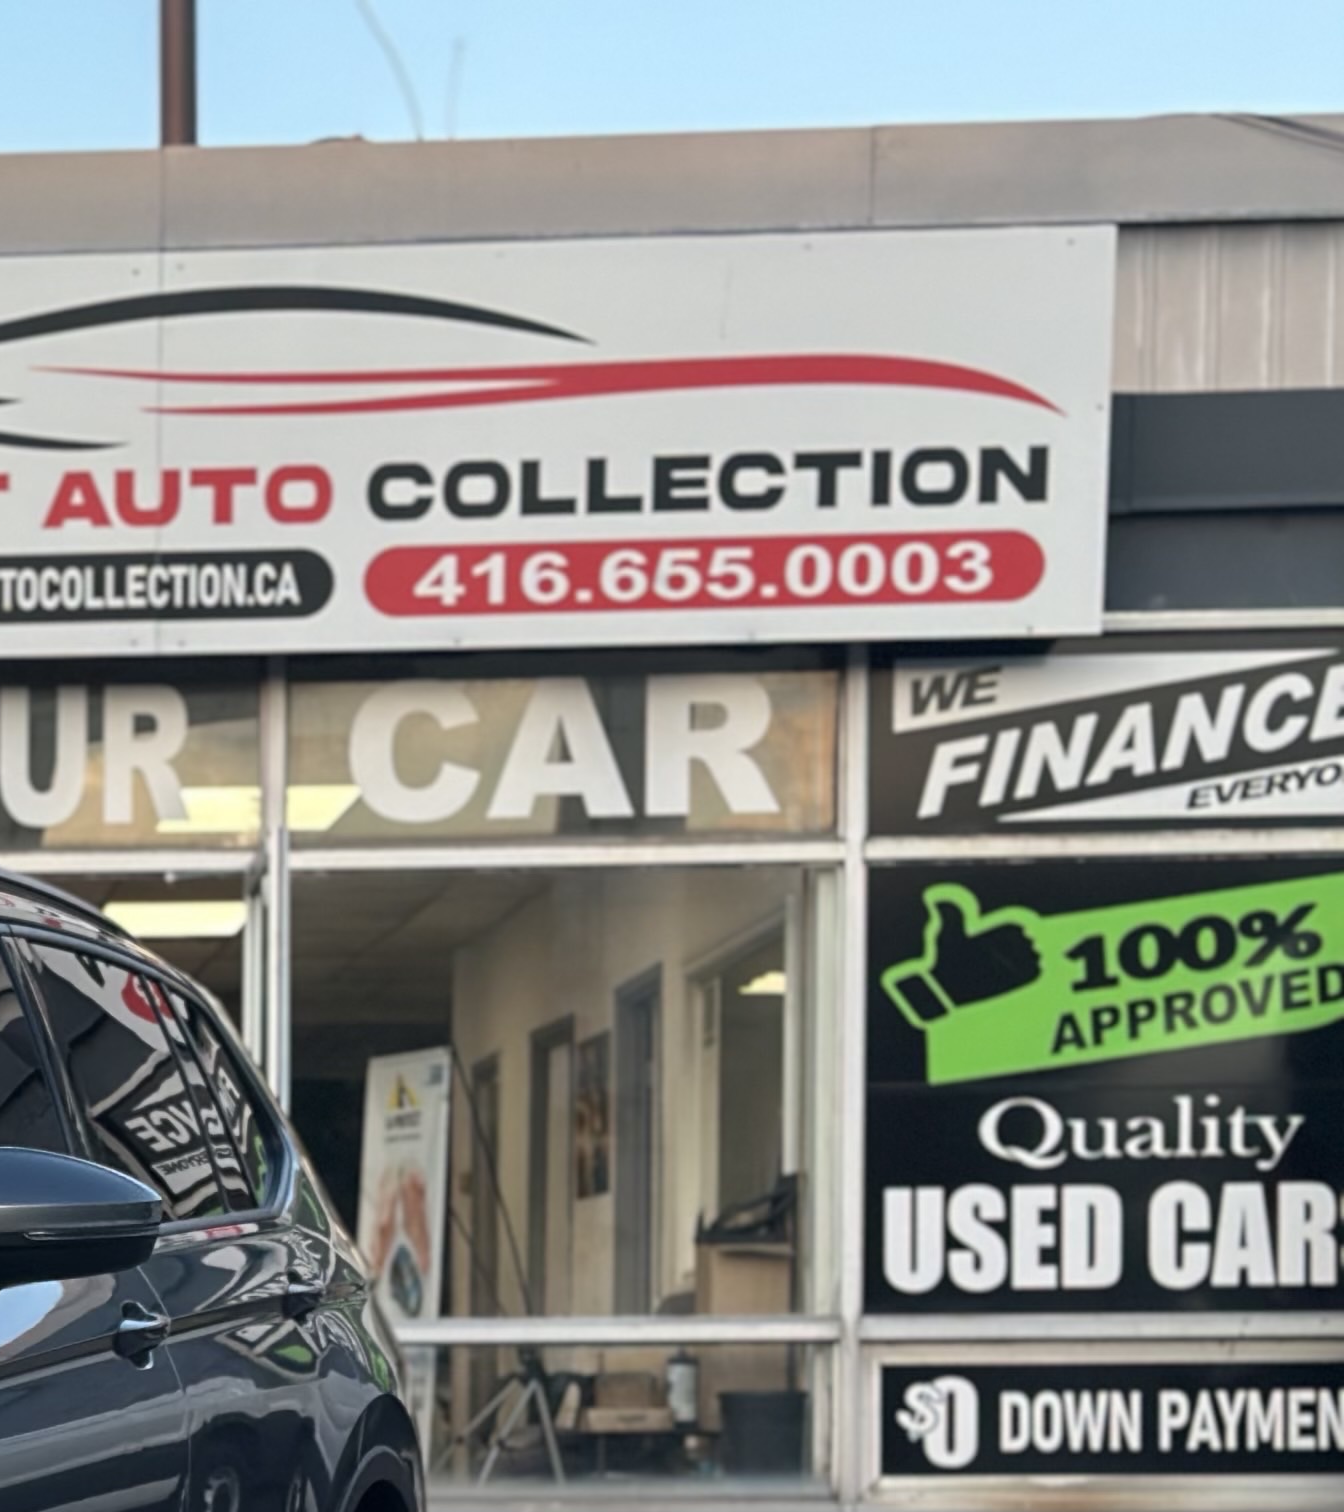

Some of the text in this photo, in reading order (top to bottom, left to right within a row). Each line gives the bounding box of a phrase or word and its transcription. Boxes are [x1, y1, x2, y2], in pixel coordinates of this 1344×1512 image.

[42, 464, 334, 530] AUTO
[367, 445, 1050, 521] COLLECTION
[413, 540, 995, 607] 416.655.0003
[908, 666, 1002, 717] WE
[349, 676, 782, 823] CAR
[1185, 762, 1344, 810] EVERYO
[1064, 900, 1323, 994] 100%
[1049, 960, 1344, 1055] APPROVED
[978, 1095, 1306, 1170] Quality
[883, 1180, 1344, 1294] USED CAR
[999, 1389, 1144, 1454] DOWN
